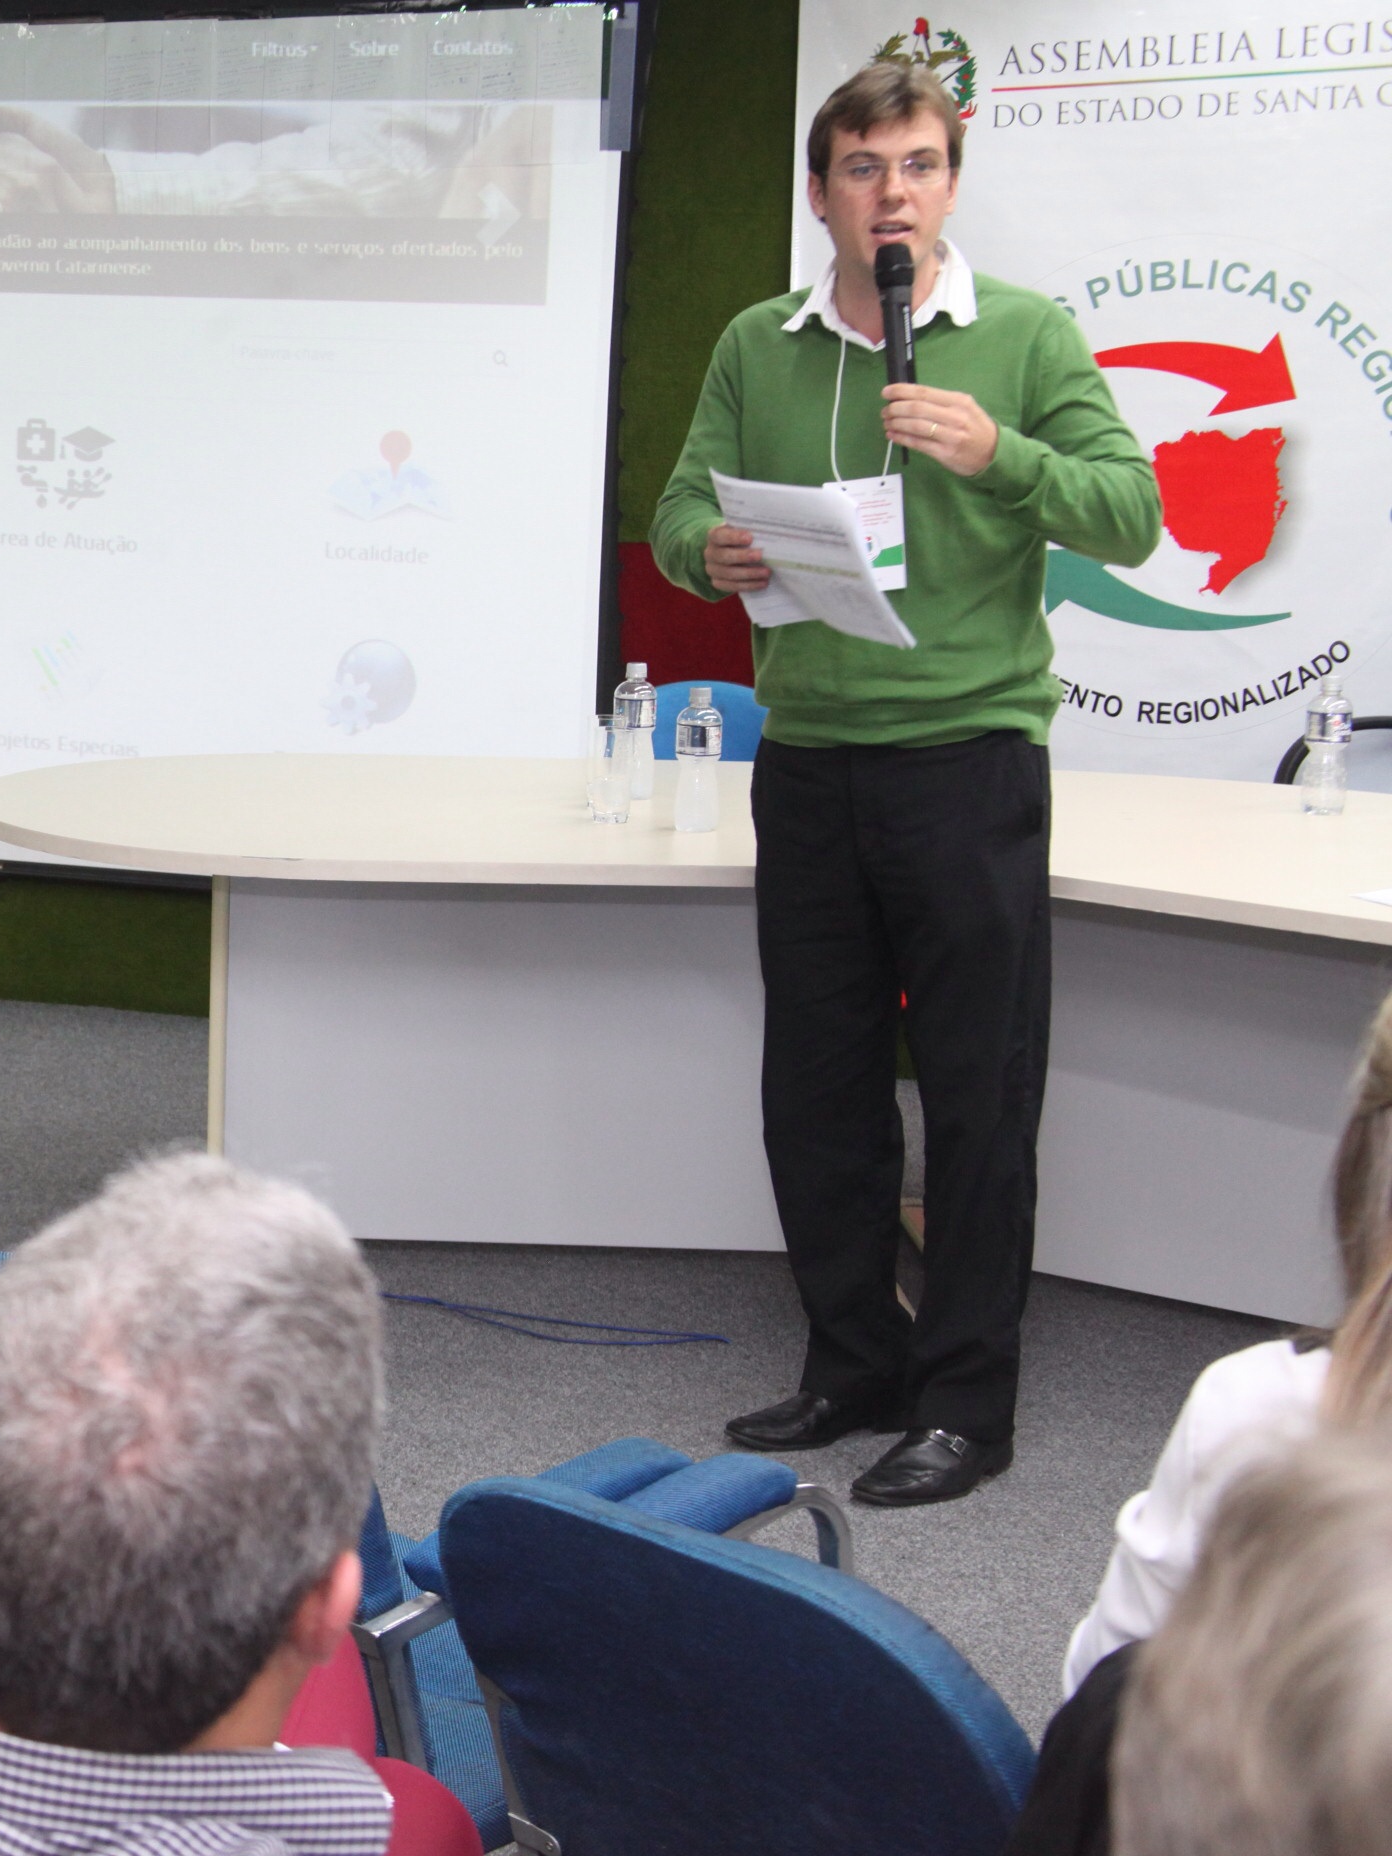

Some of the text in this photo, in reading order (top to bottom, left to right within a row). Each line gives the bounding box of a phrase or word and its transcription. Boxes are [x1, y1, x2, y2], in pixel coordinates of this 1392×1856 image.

[251, 41, 307, 57] Filtros
[349, 40, 399, 56] Sobre
[433, 40, 514, 56] Contatos
[997, 29, 1256, 76] ASSEMBLEIA
[992, 102, 1043, 129] DO
[1056, 94, 1184, 126] ESTADO
[1197, 91, 1240, 118] DE
[1254, 83, 1365, 116] SANTA
[37, 235, 57, 250] ao
[63, 236, 207, 254] acompanhamento
[214, 237, 243, 253] dos
[250, 238, 289, 254] bens
[296, 241, 308, 254] e
[314, 241, 384, 259] serviços
[391, 240, 477, 257] ofertados
[484, 242, 523, 261] pelo
[1085, 258, 1313, 314] PÚBLICAS
[34, 530, 58, 549] de
[63, 531, 138, 556] Atuação
[324, 540, 430, 564] Localidade
[1136, 640, 1351, 725] REGIONALIZADO
[57, 735, 140, 758] Especiais
